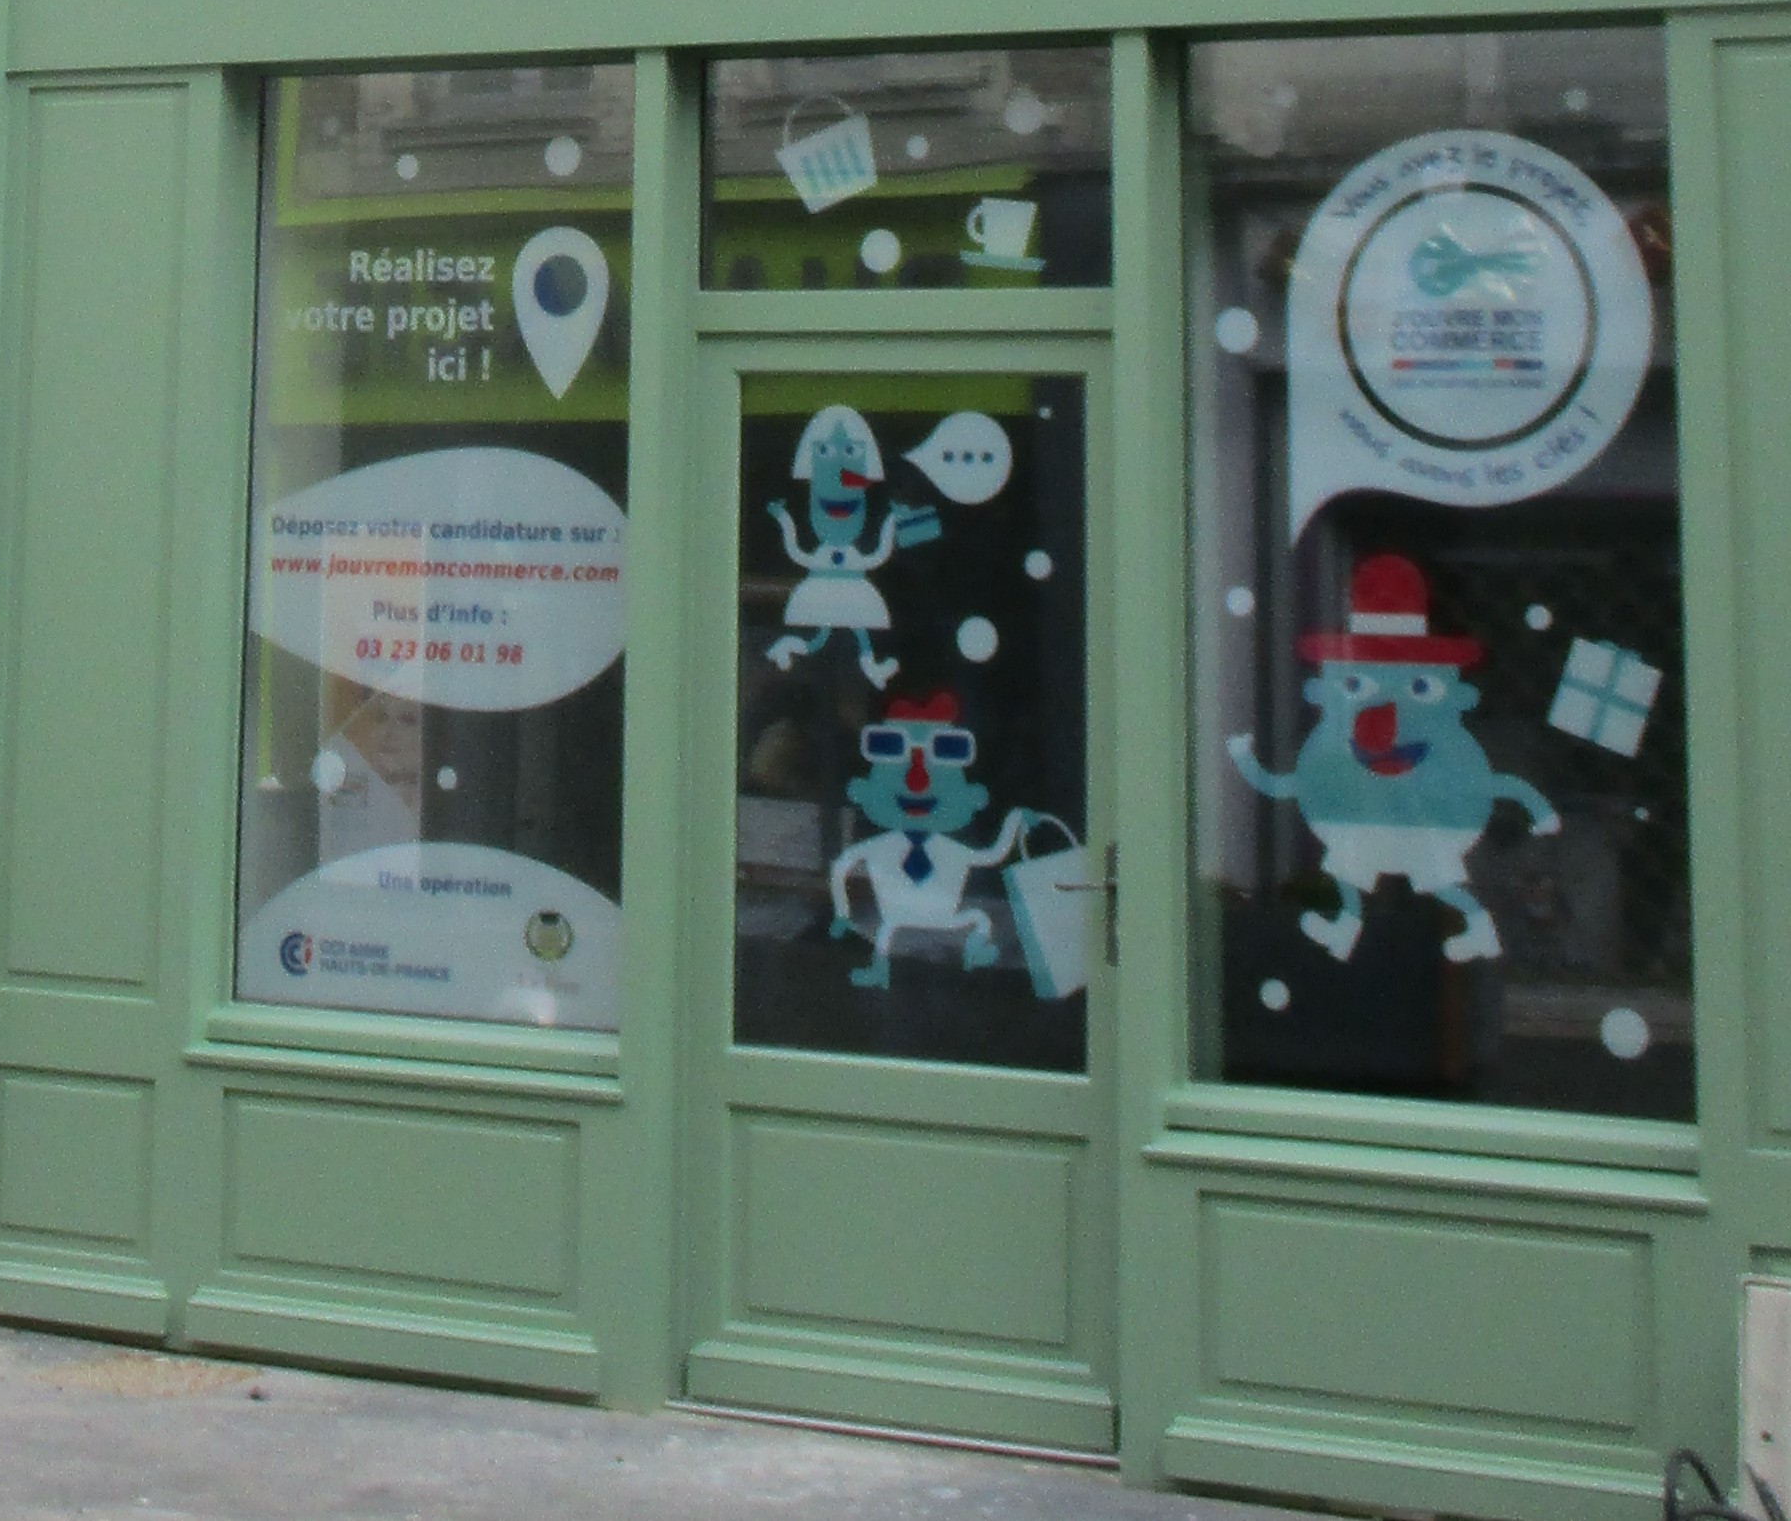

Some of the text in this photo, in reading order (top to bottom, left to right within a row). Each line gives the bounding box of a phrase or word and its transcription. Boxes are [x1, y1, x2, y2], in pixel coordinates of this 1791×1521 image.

[350, 248, 495, 282] Réalisez
[285, 298, 495, 339] votre projet
[1392, 330, 1545, 352] COMMERCE
[427, 347, 493, 382] ici !
[271, 514, 359, 539] Déposez
[366, 519, 422, 538] votre
[429, 519, 562, 542] candidature
[570, 525, 606, 543] sur
[271, 554, 620, 583] www.jouvremoncommerce.com
[373, 600, 418, 622] Plus
[426, 601, 494, 625] d'info
[356, 638, 382, 659] 03
[390, 640, 417, 660] 23
[425, 641, 452, 661] 06
[460, 643, 485, 663] 01
[379, 870, 512, 896] Une opération
